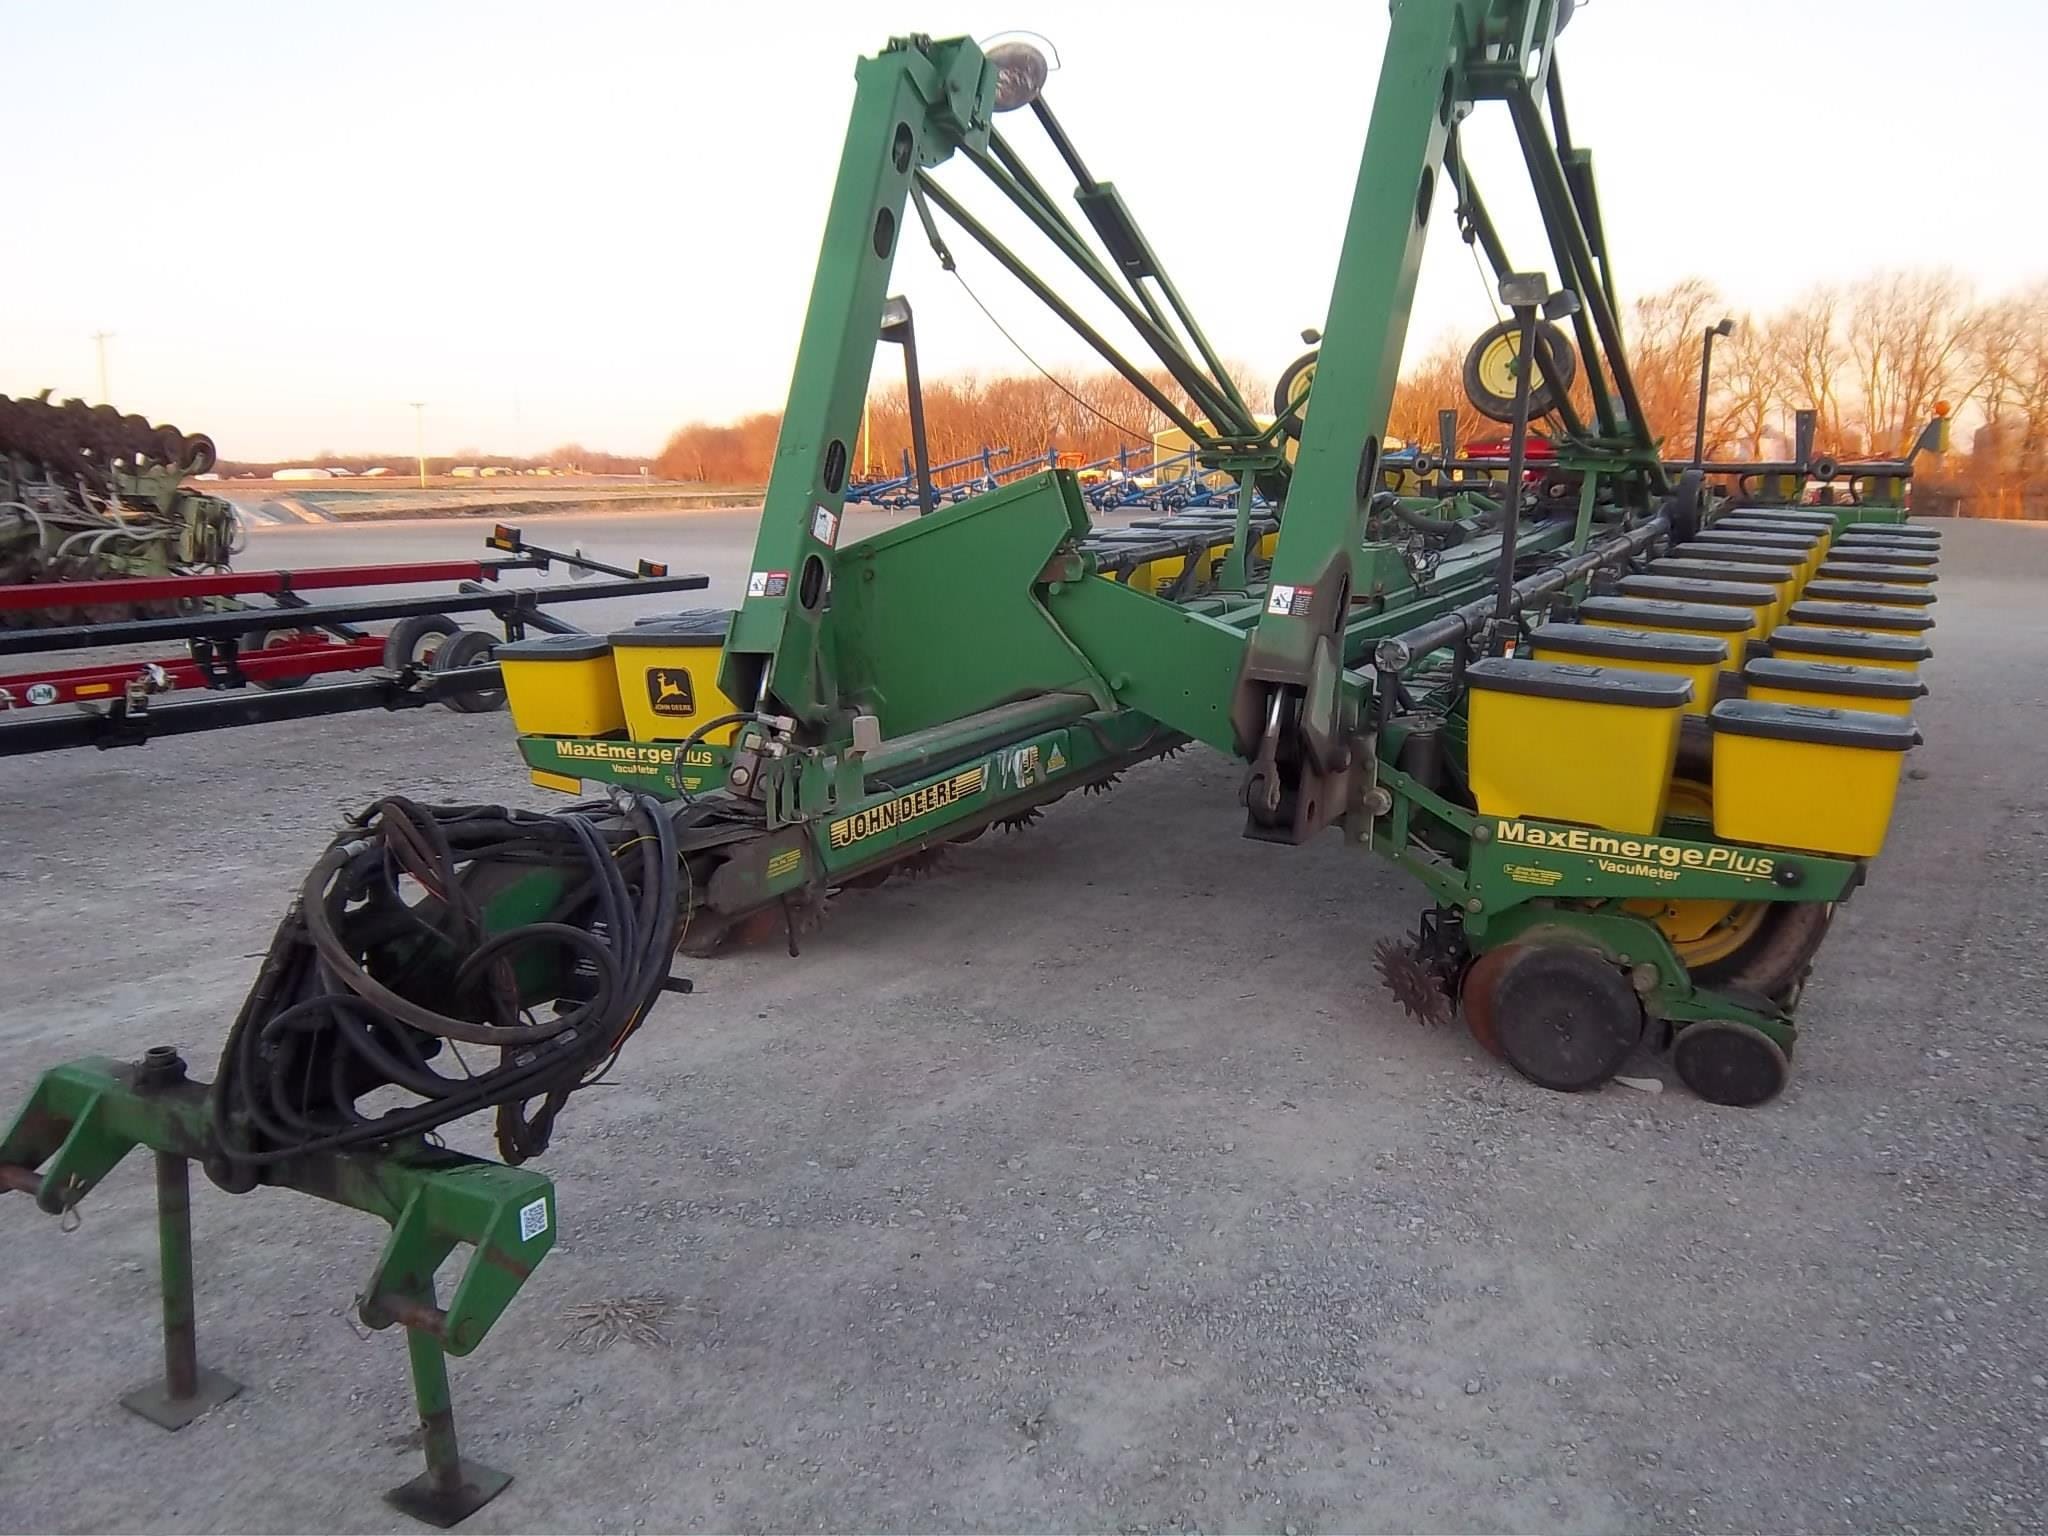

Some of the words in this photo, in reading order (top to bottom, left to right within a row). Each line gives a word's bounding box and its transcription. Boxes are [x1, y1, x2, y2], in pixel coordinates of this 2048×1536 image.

[841, 802, 896, 845] JOHN
[900, 778, 958, 820] DEERE
[1599, 859, 1680, 881] VacuMeter
